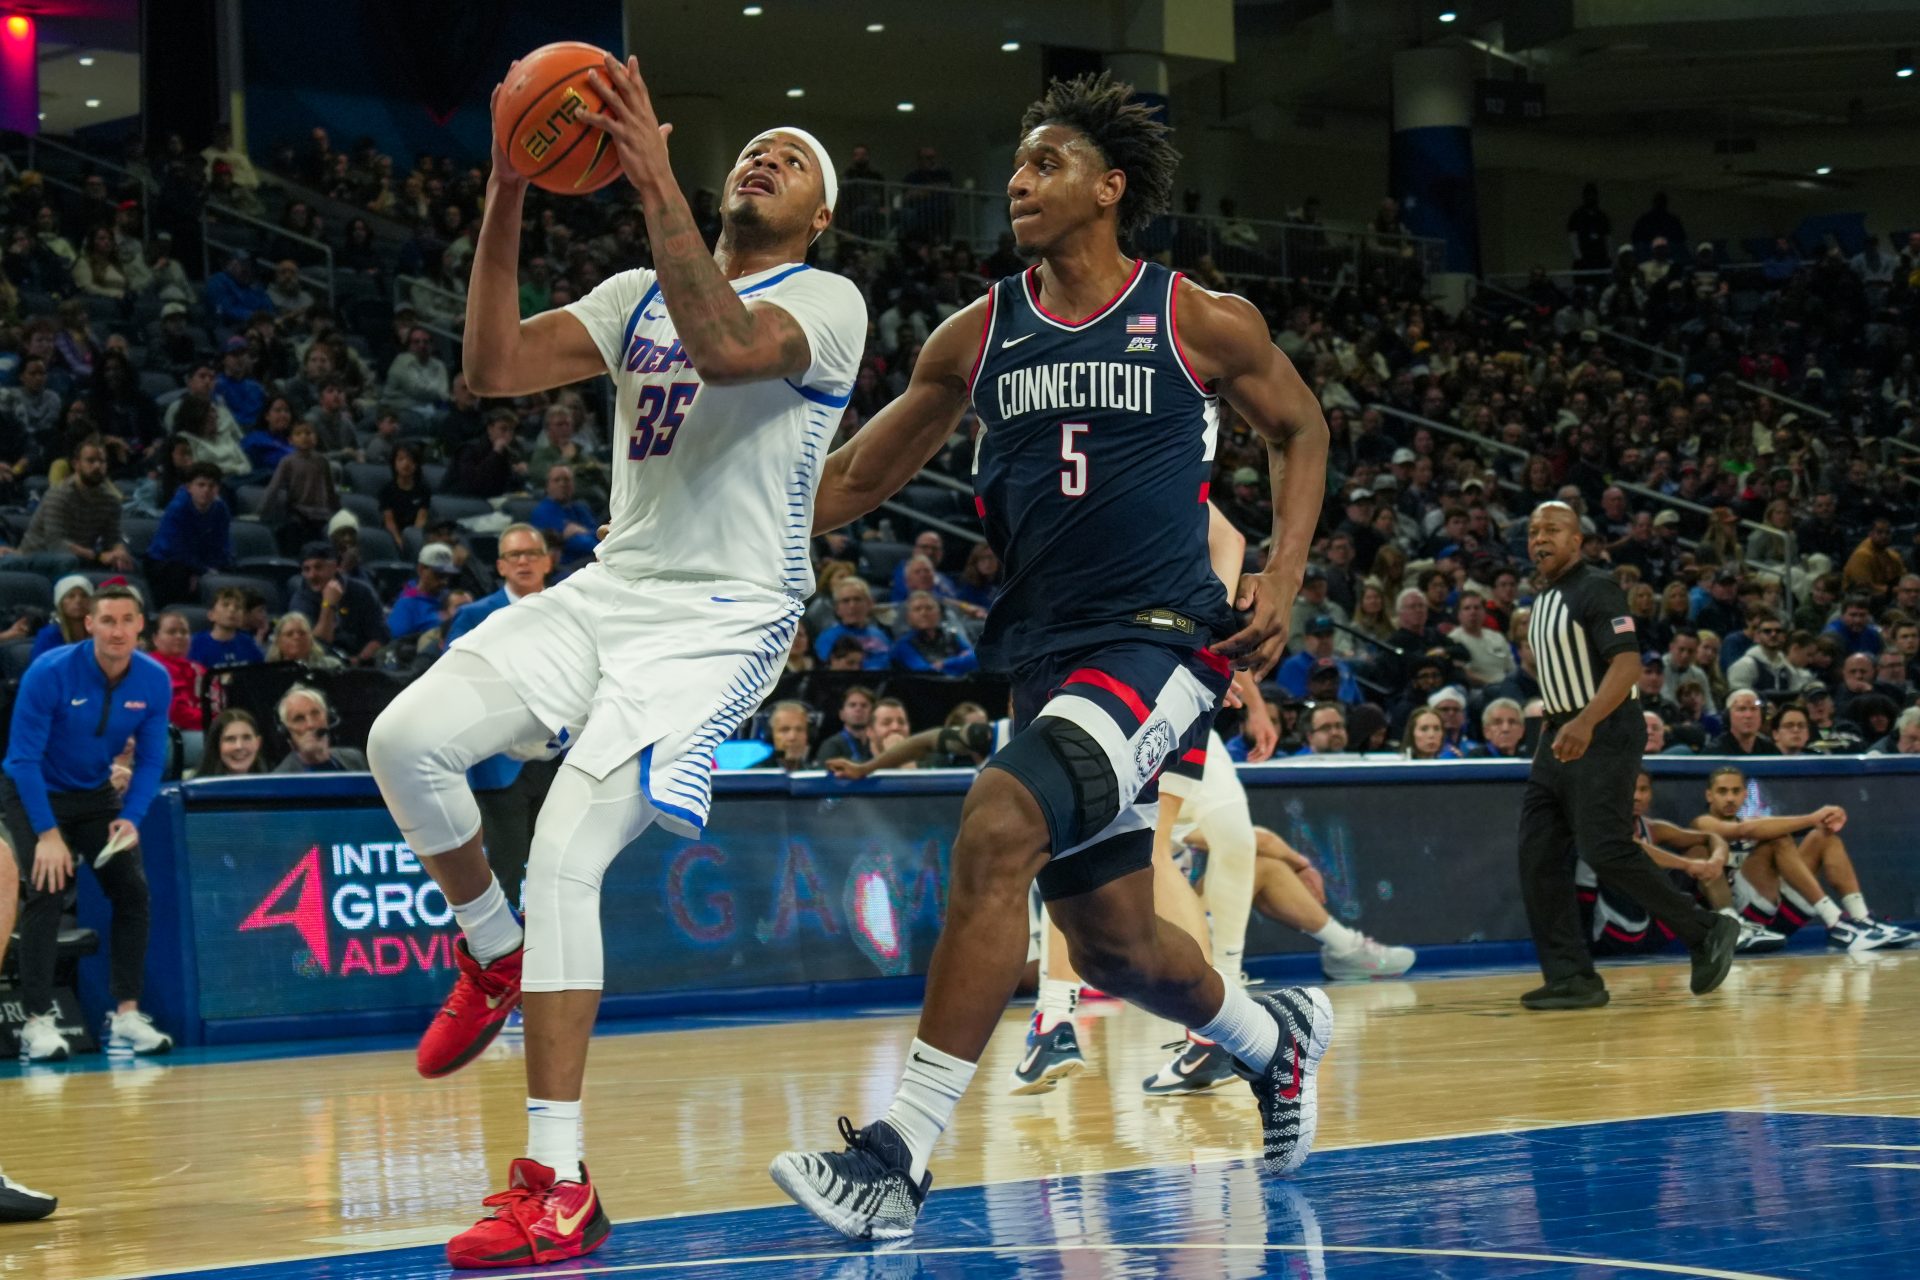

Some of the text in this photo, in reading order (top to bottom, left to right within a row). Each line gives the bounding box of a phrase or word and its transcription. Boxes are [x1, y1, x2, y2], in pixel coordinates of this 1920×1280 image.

[626, 335, 695, 374] DEP
[1131, 336, 1153, 344] BIG
[997, 361, 1156, 420] CONNECTICUT
[628, 382, 700, 461] 35
[1060, 422, 1090, 497] 5
[1176, 618, 1187, 628] 52
[331, 843, 421, 876] INTE
[332, 883, 457, 929] GRO
